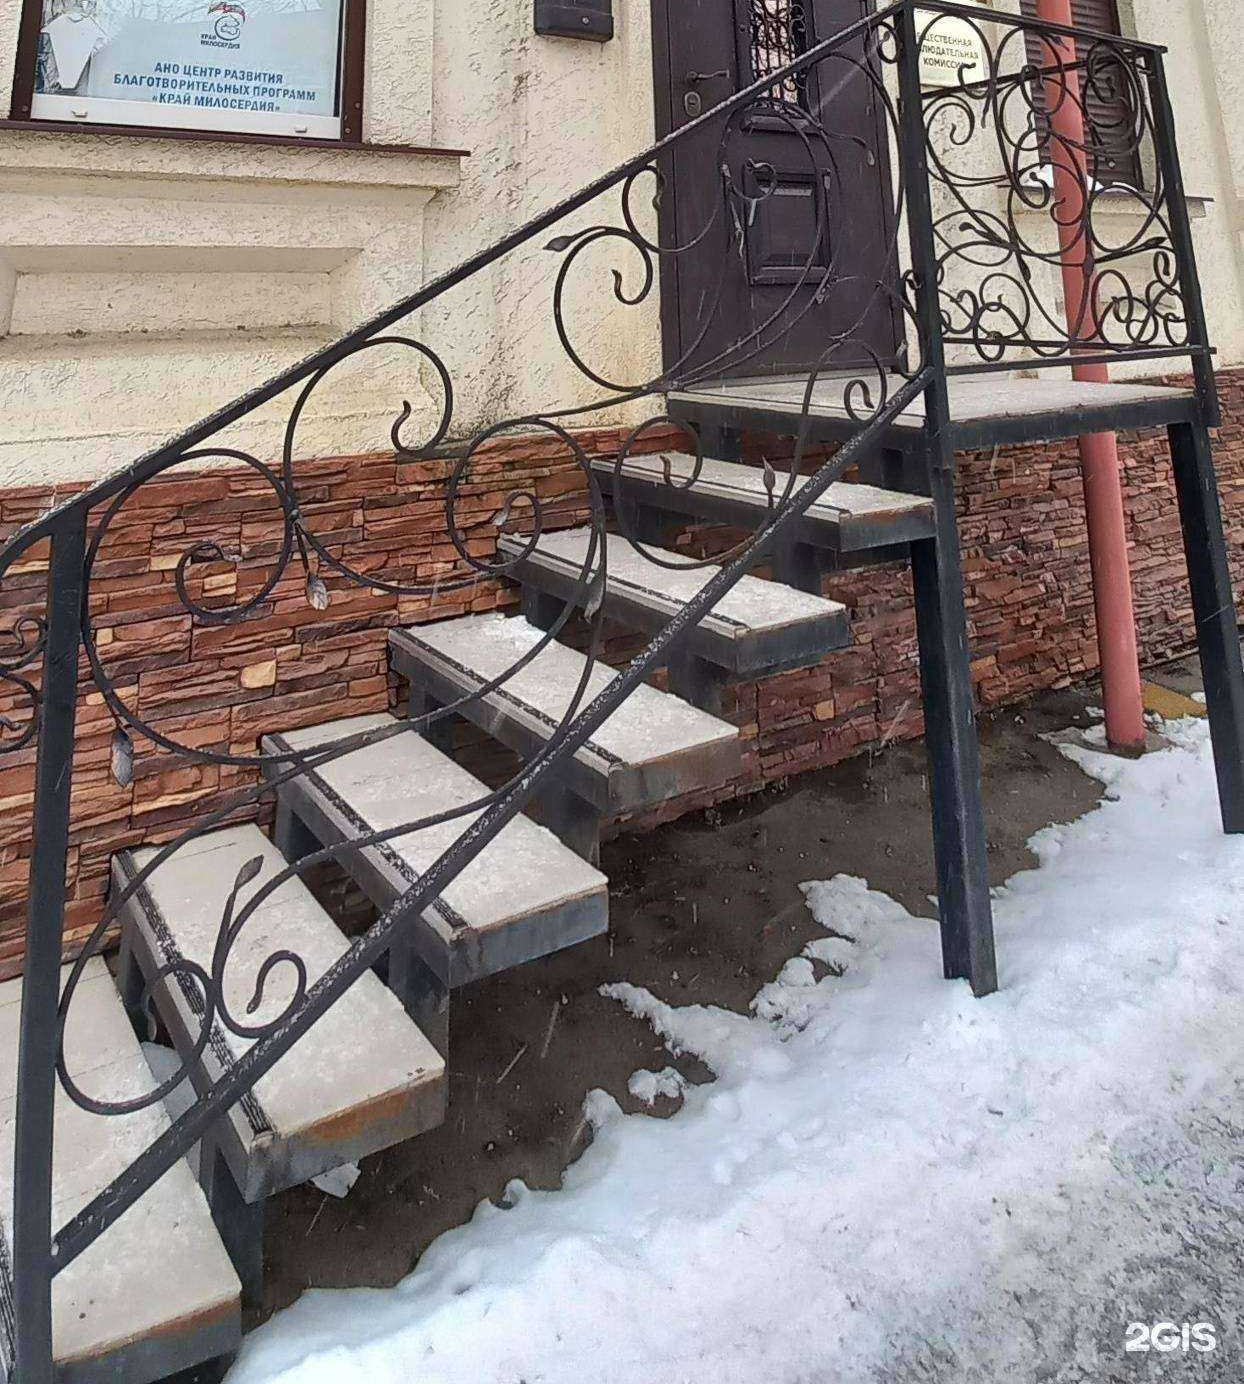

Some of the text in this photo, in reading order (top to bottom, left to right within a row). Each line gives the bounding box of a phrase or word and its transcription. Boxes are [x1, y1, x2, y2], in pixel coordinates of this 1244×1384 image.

[155, 62, 283, 84] АНО ЦЕНТР РАЗВИТИЯ
[114, 73, 316, 101] БЛАГОТВОРИТЕЛЬНЫХ ПРОГРАММ
[151, 91, 281, 112] «КРАЙ МИЛОСЕРДИЯ»
